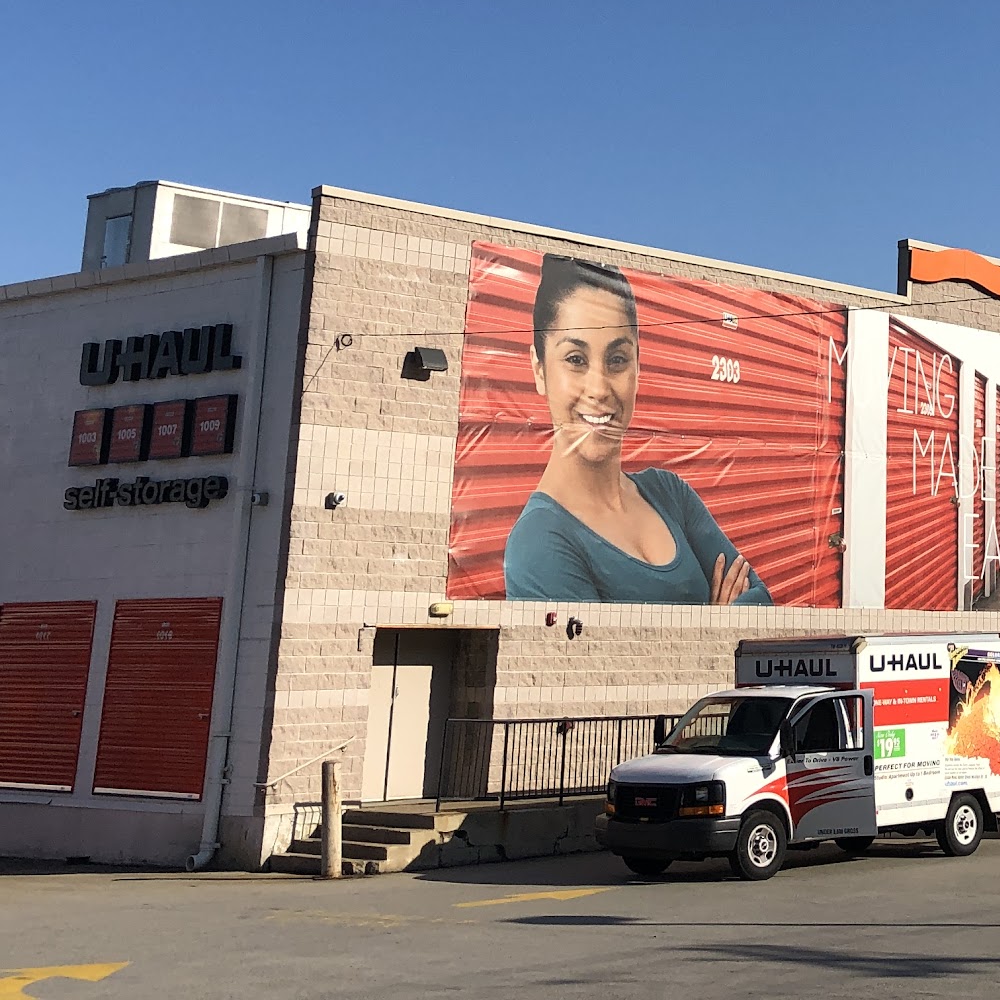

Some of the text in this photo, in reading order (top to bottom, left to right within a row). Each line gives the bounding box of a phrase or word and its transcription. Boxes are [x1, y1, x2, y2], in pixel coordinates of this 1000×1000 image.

[80, 324, 241, 386] U-HAUL
[711, 355, 740, 384] 2303
[829, 336, 955, 419] MING
[117, 428, 137, 440] 1005
[157, 424, 178, 436] 1007
[199, 419, 220, 432] 1009
[78, 432, 97, 444] 1003
[912, 428, 997, 502] MADE
[64, 476, 229, 511] self-storage
[755, 658, 837, 678] U-HAUL
[869, 652, 942, 673] U-HAUL
[874, 762, 902, 772] PERFECT
[903, 761, 915, 769] FOR
[916, 759, 941, 768] MOVING
